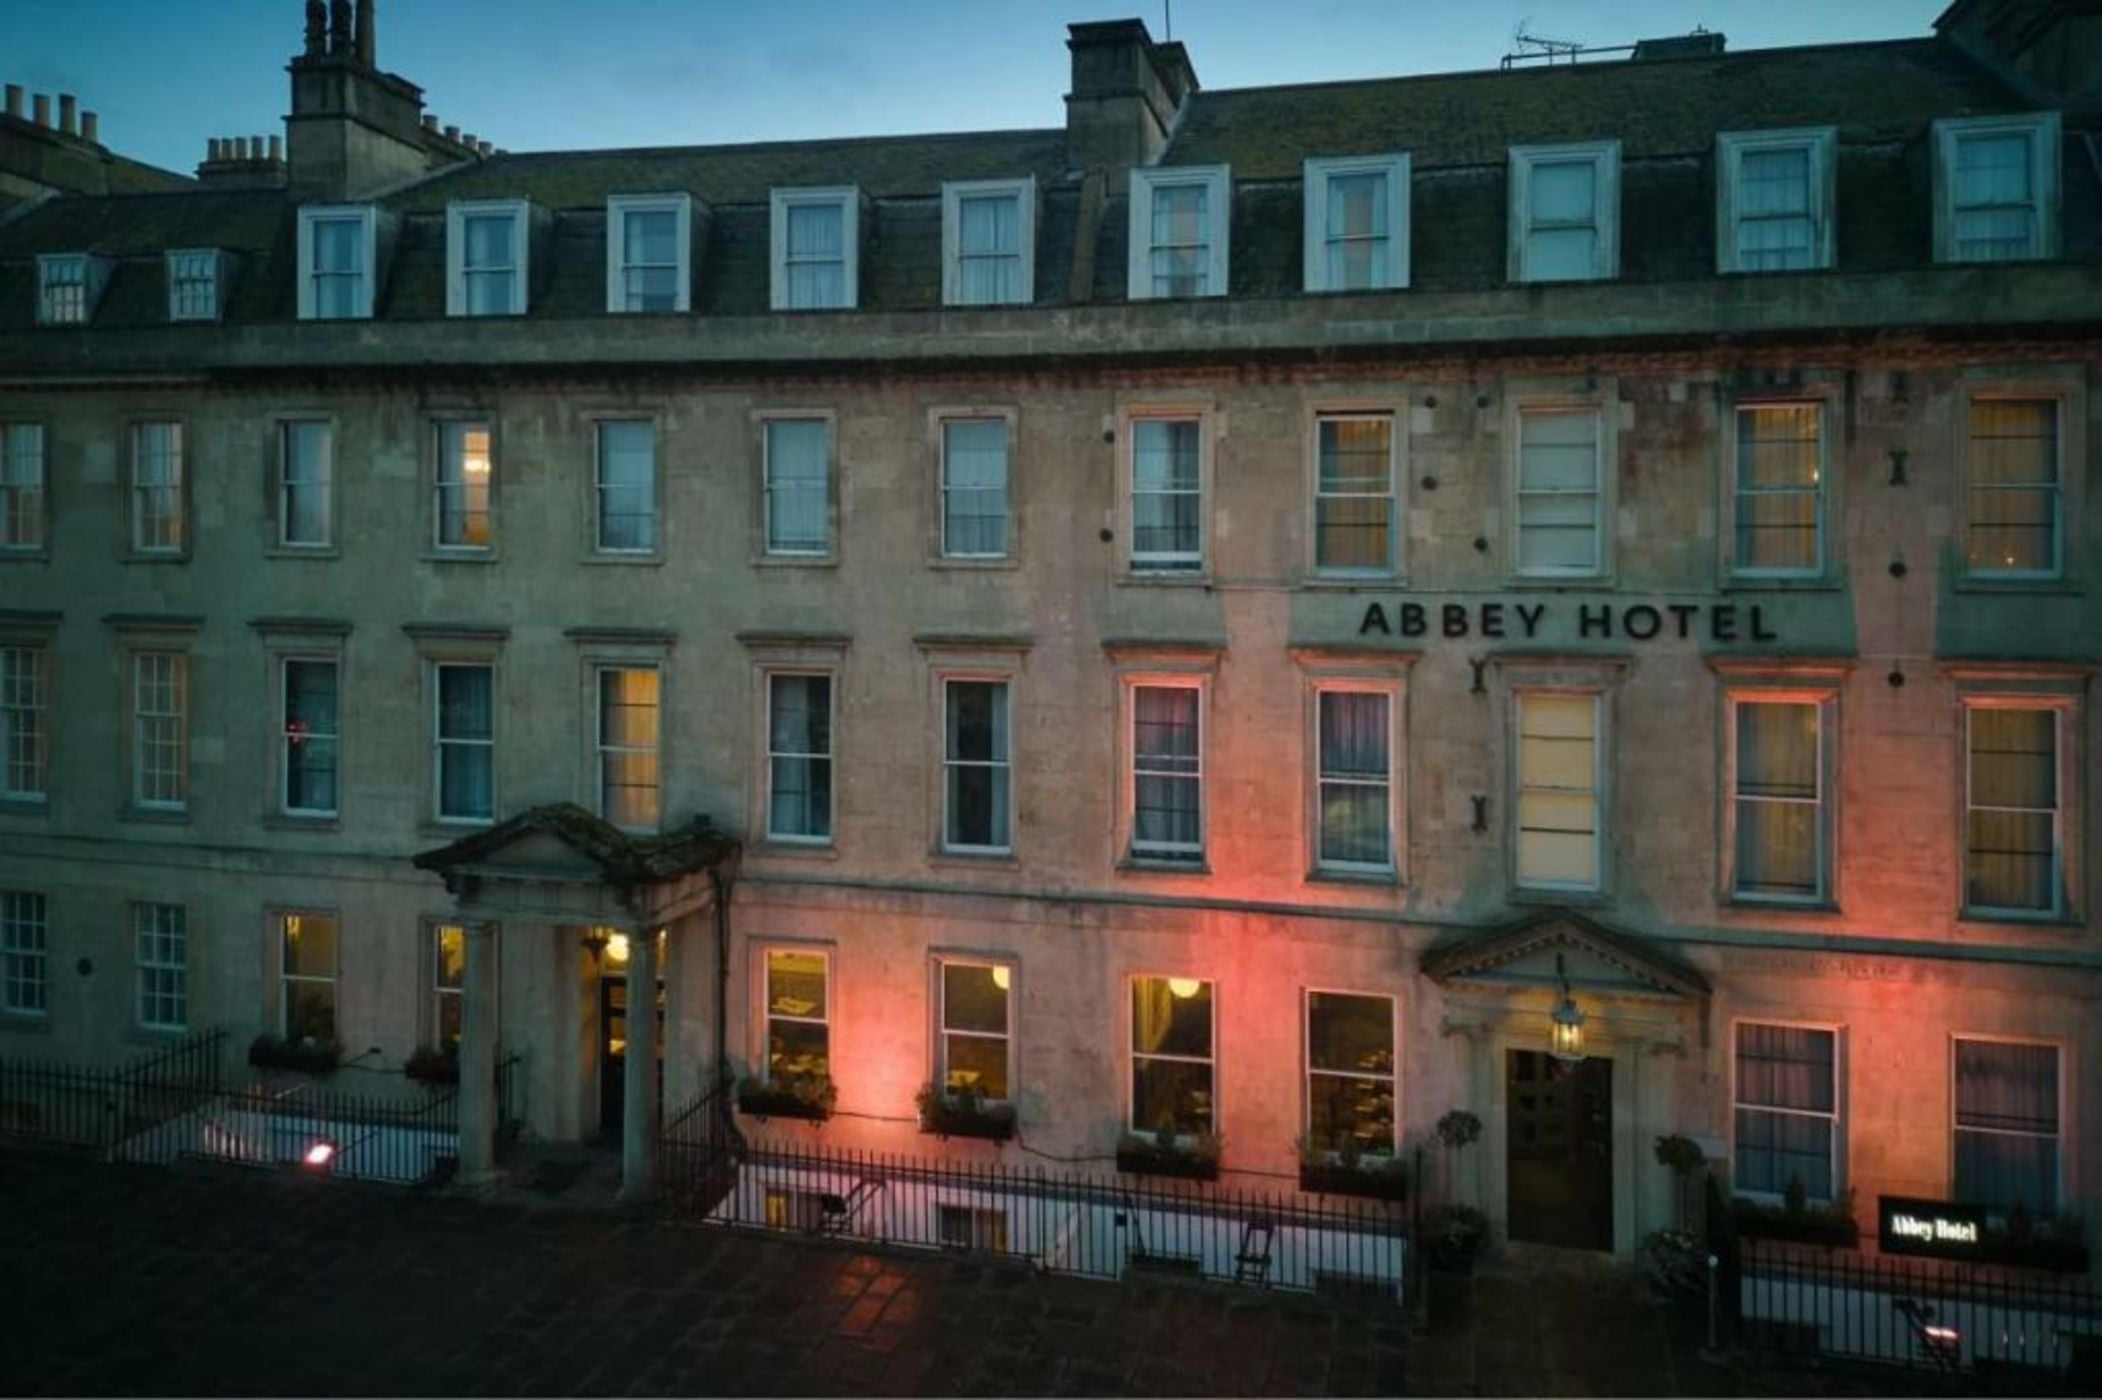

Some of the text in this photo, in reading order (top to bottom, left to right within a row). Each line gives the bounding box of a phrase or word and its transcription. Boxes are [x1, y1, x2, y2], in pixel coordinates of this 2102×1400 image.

[1359, 602, 1777, 641] ABBEY HOTEL
[1892, 1215, 1977, 1242] Abbey Hotel
